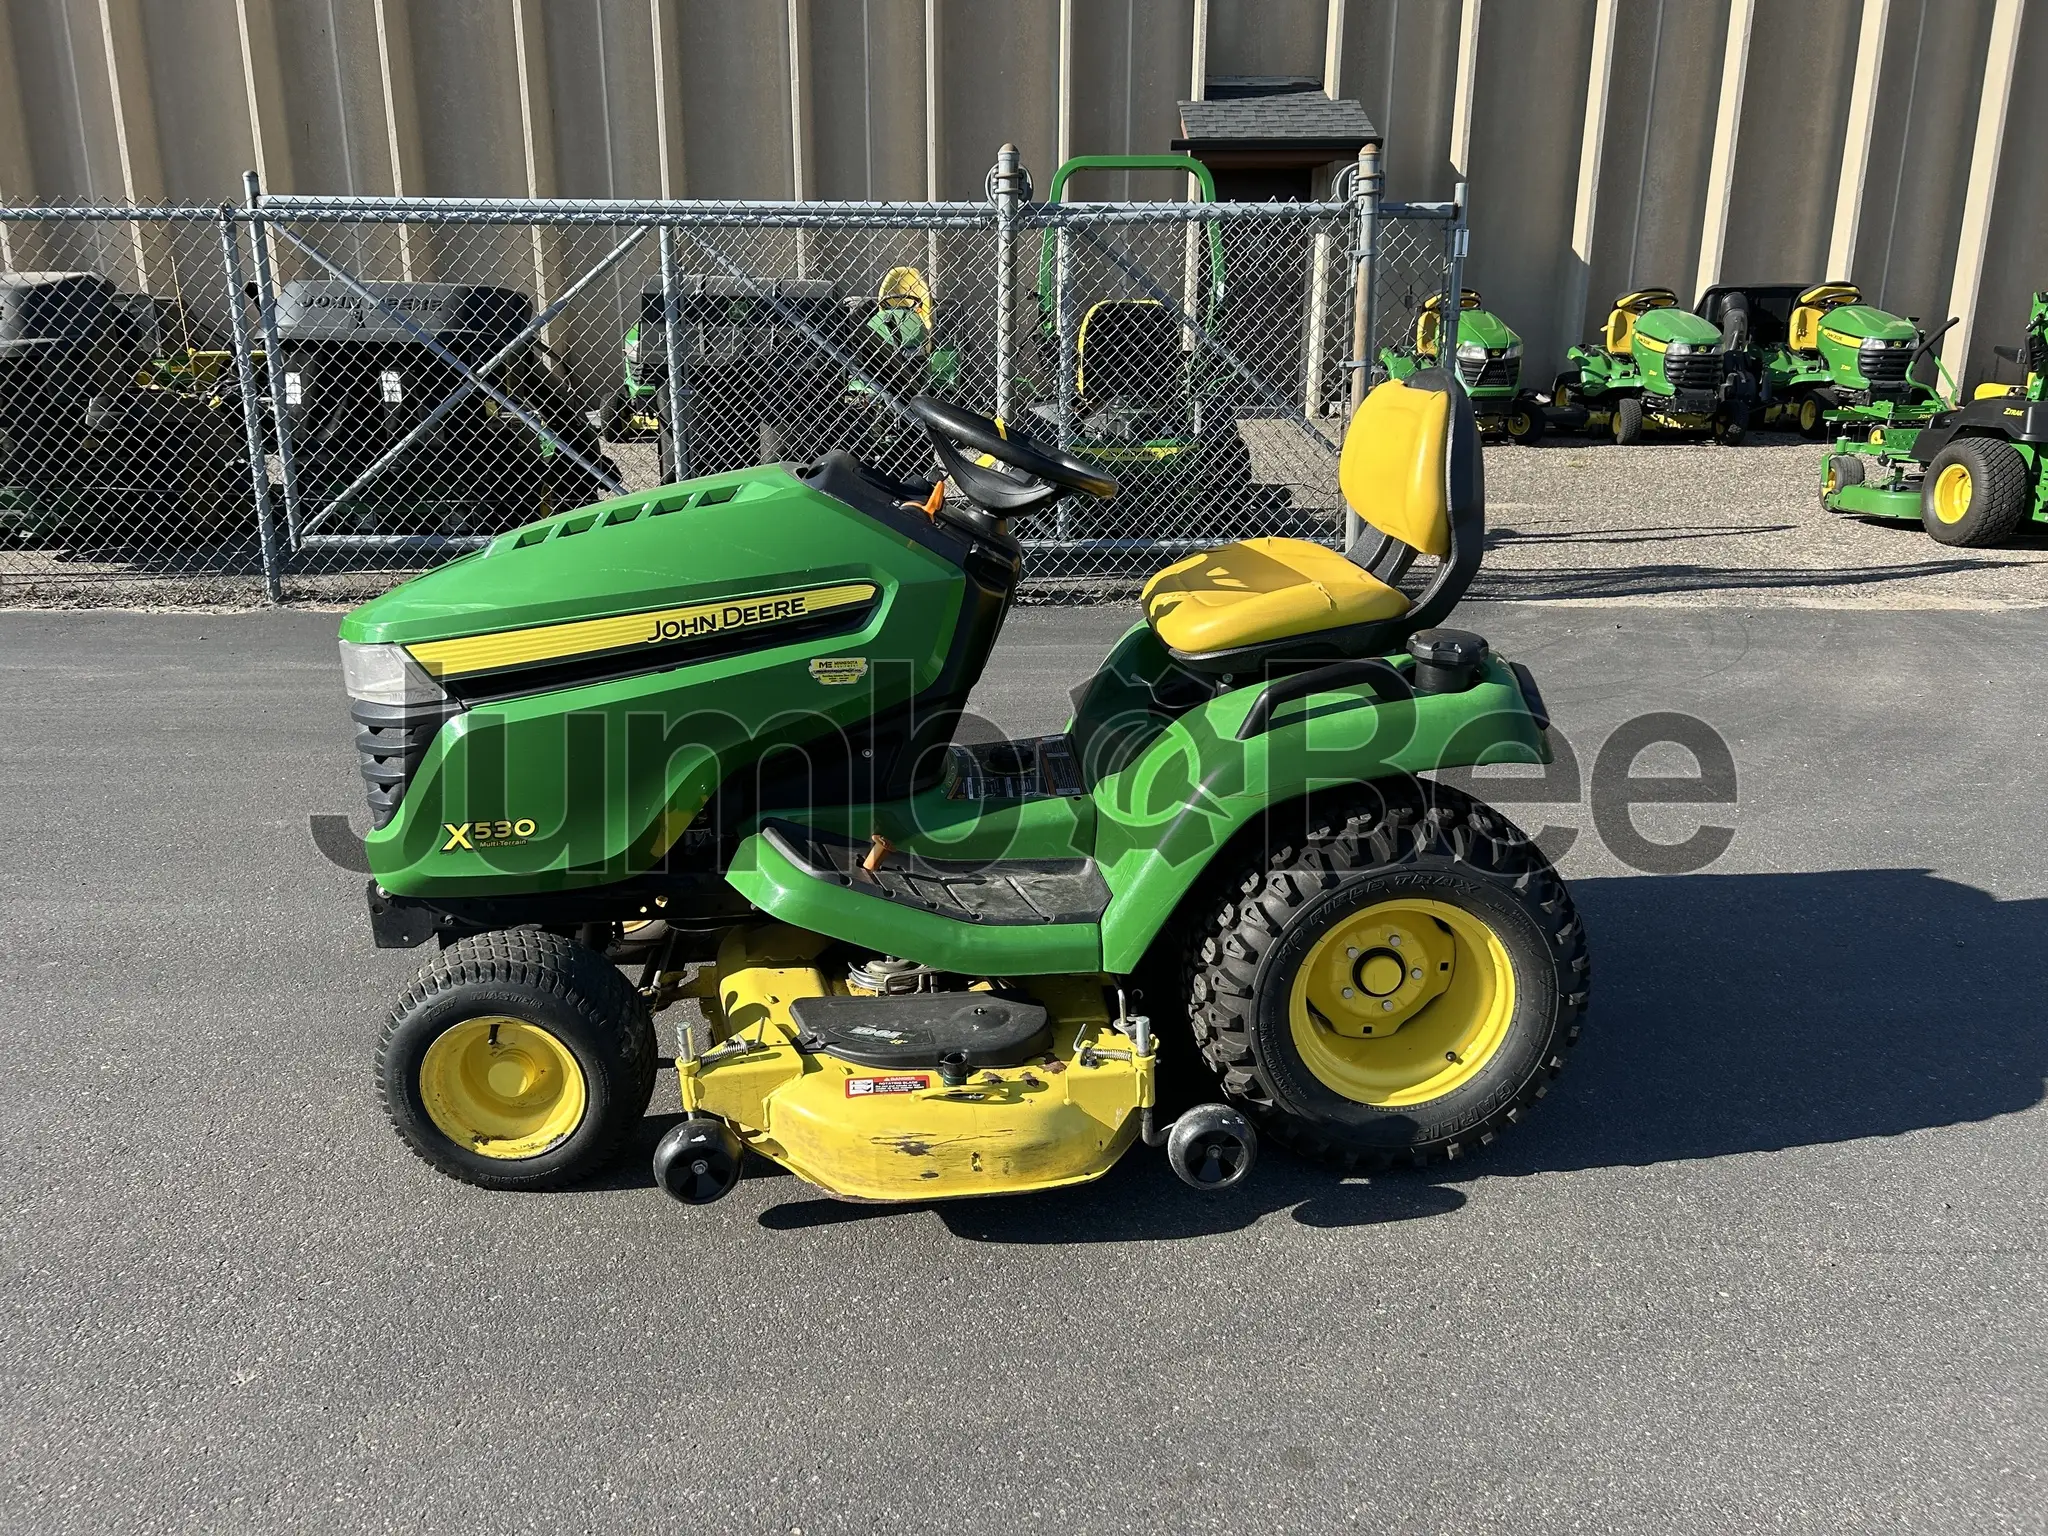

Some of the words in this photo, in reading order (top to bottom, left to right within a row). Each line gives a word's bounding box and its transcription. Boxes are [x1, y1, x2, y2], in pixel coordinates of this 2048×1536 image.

[647, 613, 717, 642] JOHN
[722, 597, 807, 628] DEERE
[441, 818, 537, 851] X530
[1394, 874, 1481, 893] TRAX
